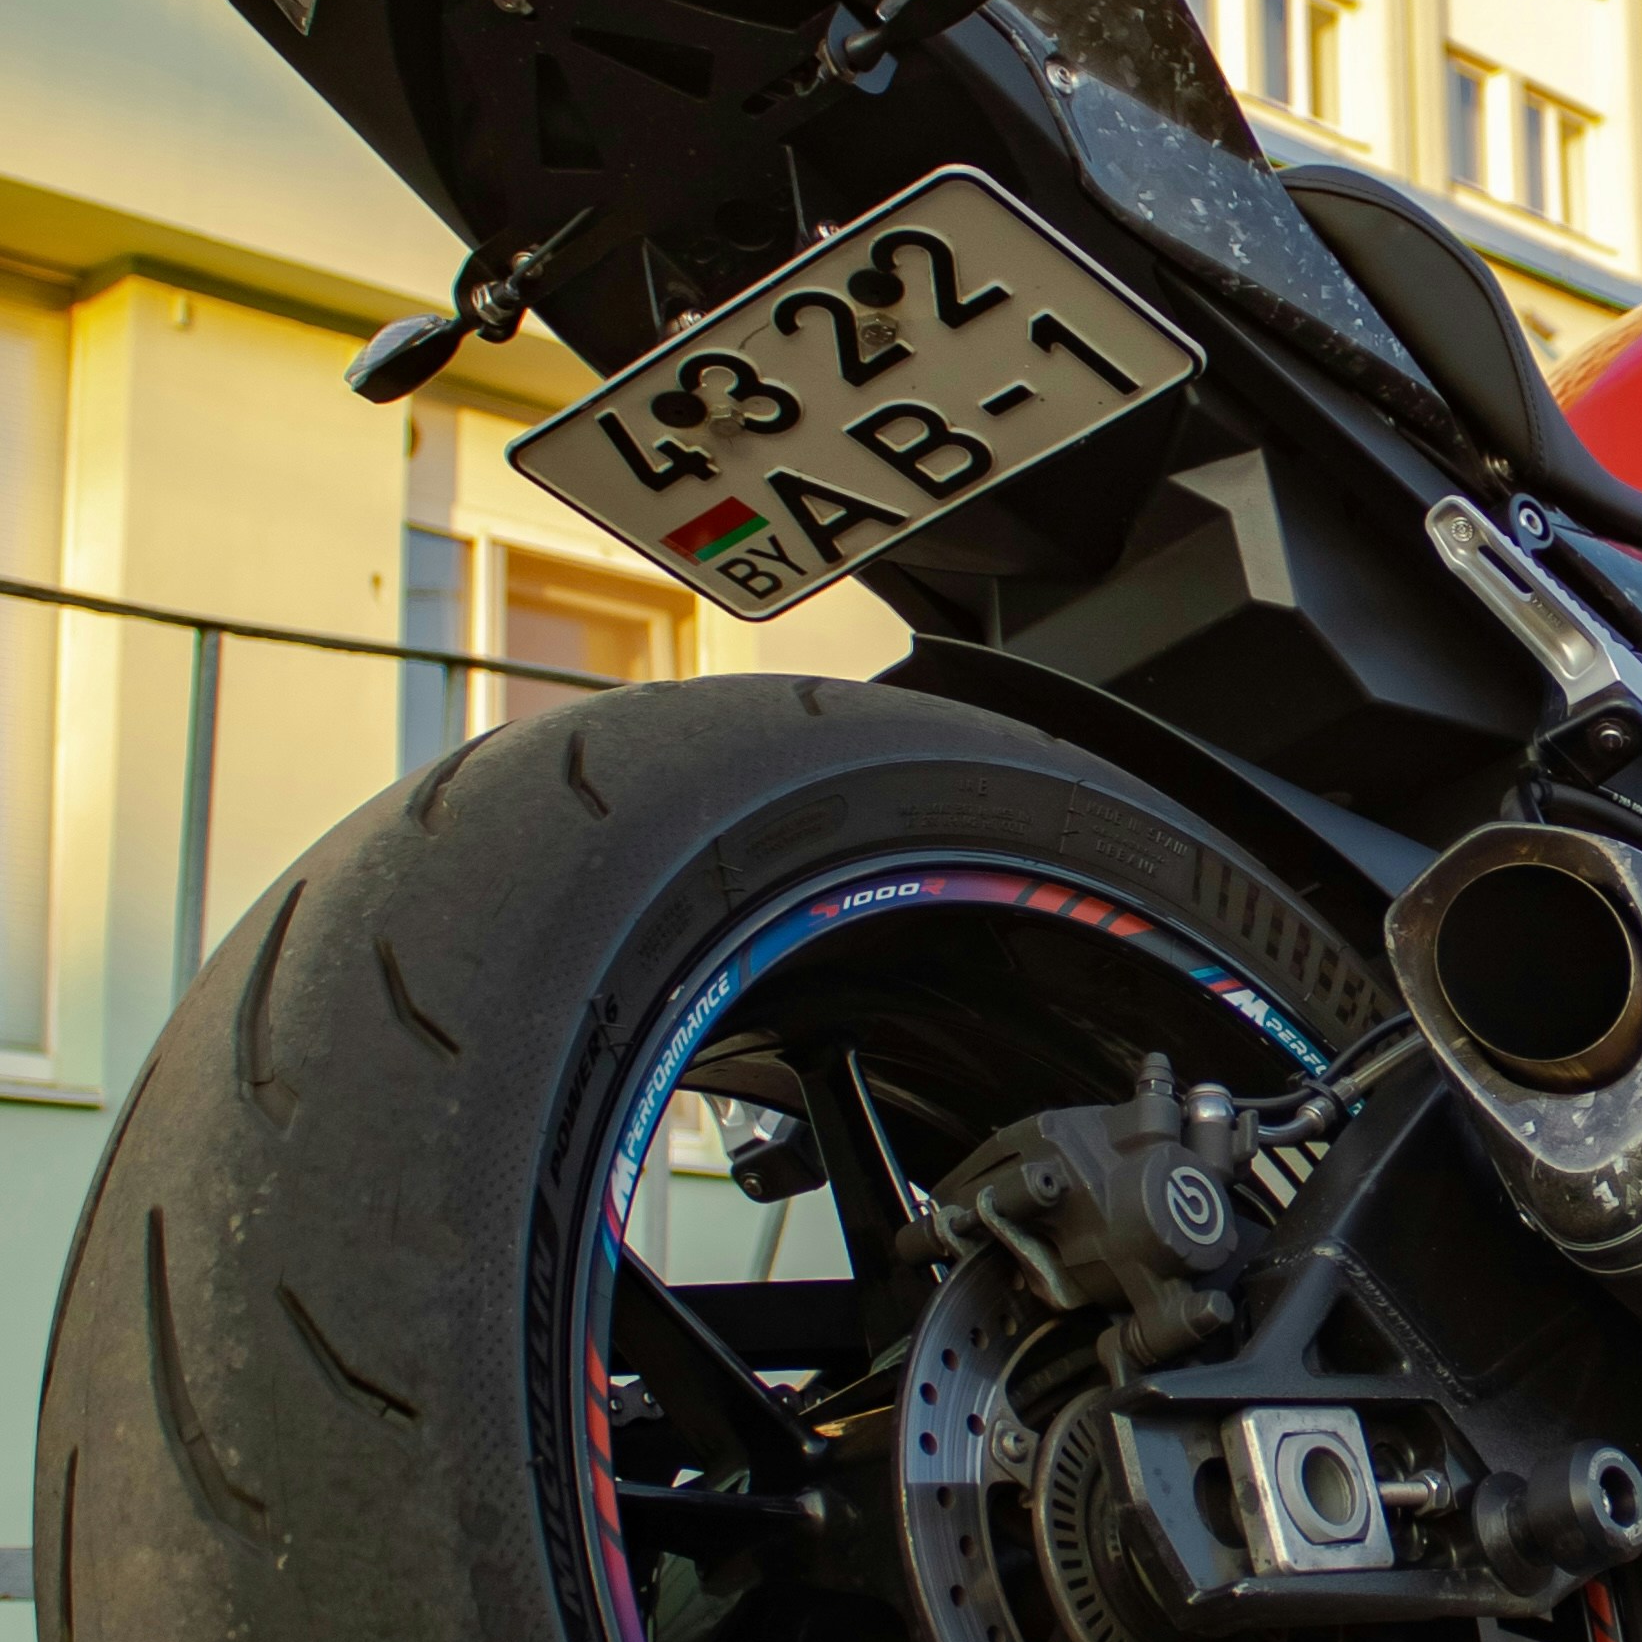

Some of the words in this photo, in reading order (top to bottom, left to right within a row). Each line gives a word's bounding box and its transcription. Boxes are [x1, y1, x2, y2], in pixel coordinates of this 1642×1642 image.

[596, 225, 1012, 491] 4322
[765, 310, 1142, 563] AB-1
[716, 535, 808, 600] BY
[626, 969, 731, 1156] PERFORMANCE
